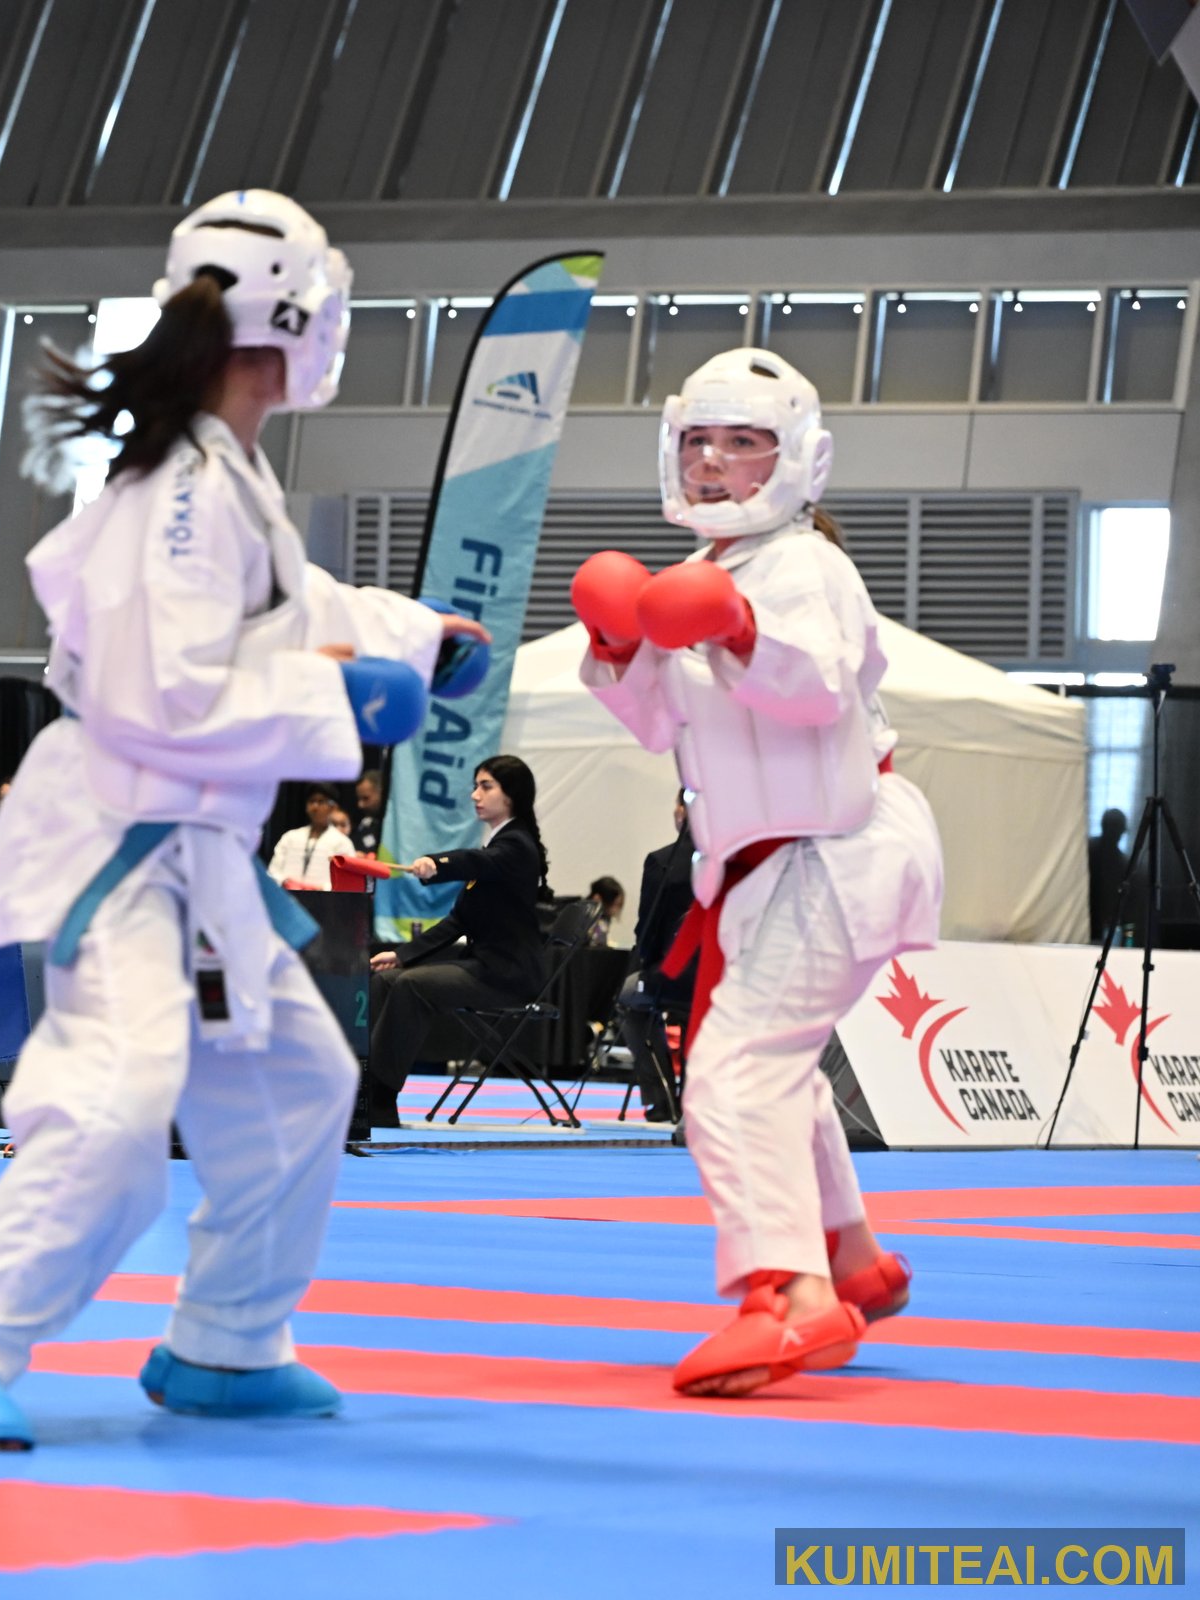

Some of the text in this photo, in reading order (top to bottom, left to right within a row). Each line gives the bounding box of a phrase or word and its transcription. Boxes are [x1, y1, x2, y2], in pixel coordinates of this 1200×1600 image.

[418, 536, 503, 810] Fir Aid
[355, 990, 368, 1027] 2
[939, 1049, 1020, 1083] KARATE
[1149, 1055, 1200, 1086] KARAT
[958, 1088, 1041, 1121] CANADA
